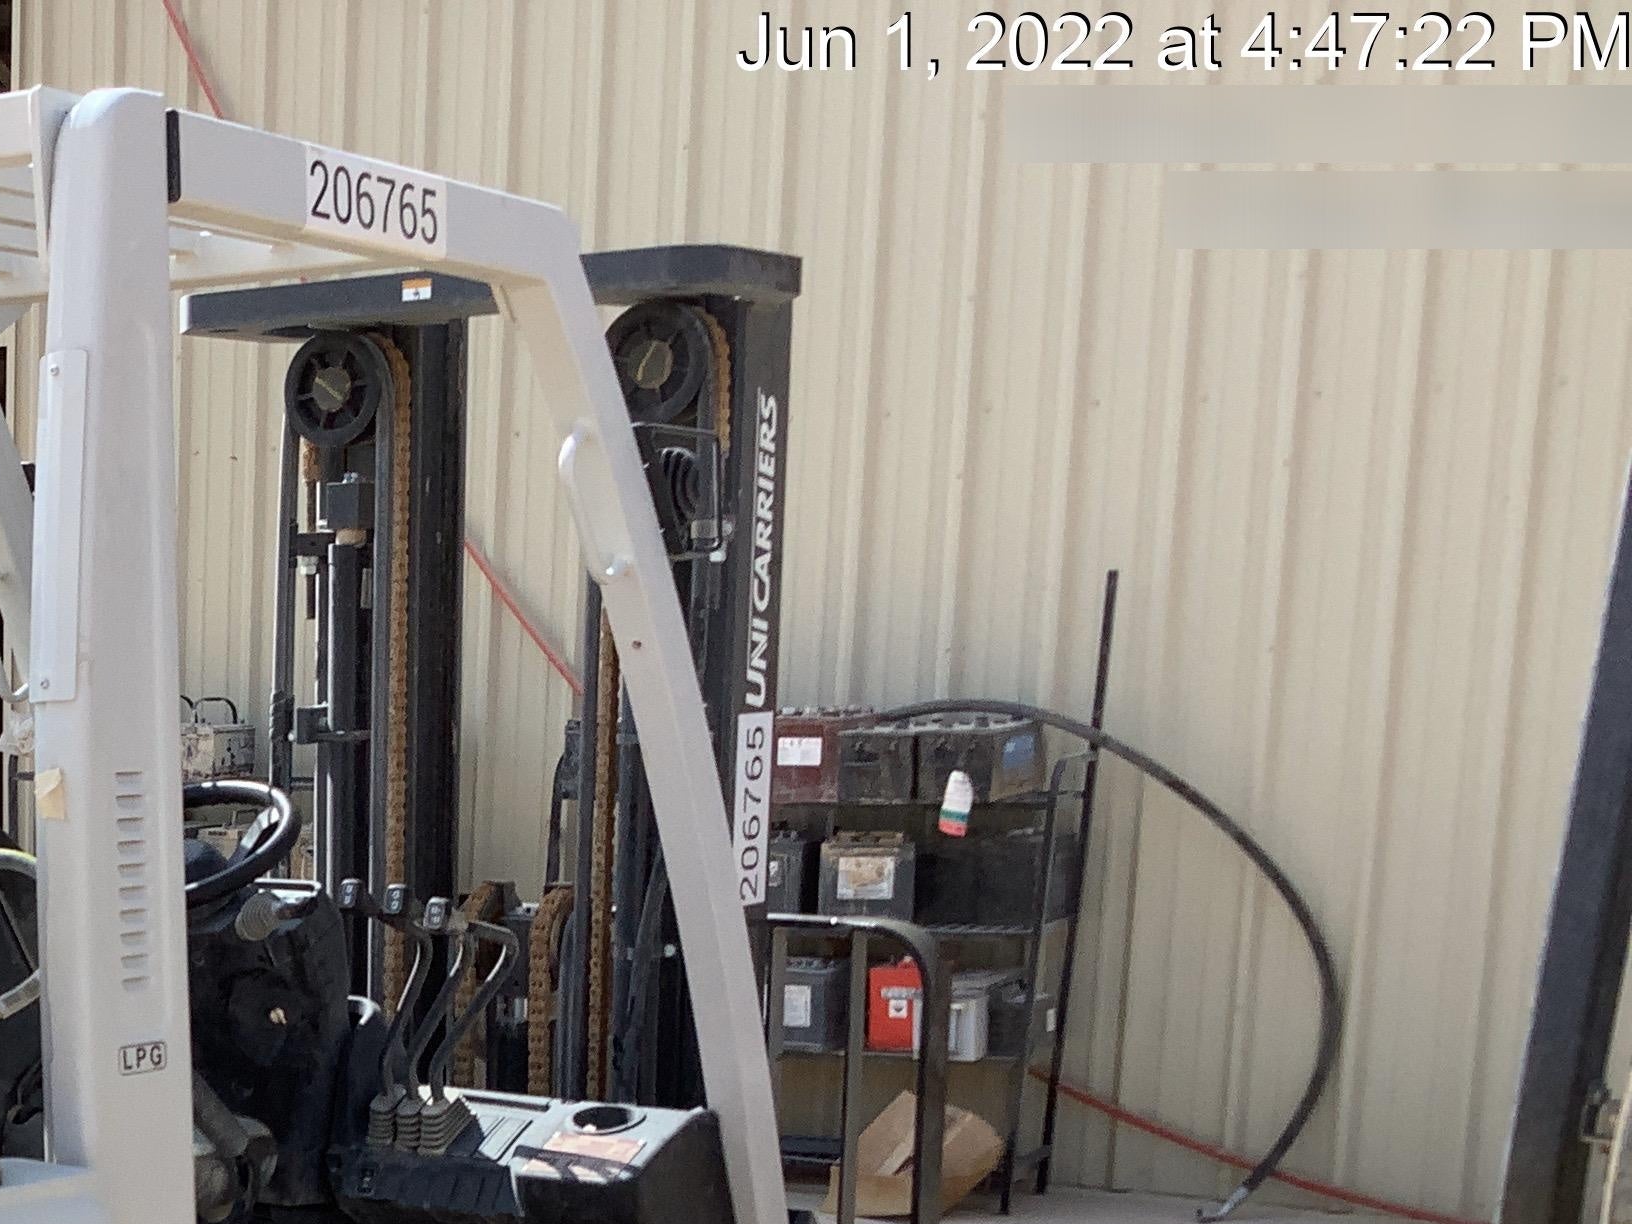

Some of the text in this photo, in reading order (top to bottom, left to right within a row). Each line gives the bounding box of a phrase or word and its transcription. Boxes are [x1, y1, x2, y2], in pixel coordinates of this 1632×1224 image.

[309, 159, 438, 244] 206765
[739, 725, 765, 901] 206765
[122, 1045, 163, 1071] LPG
